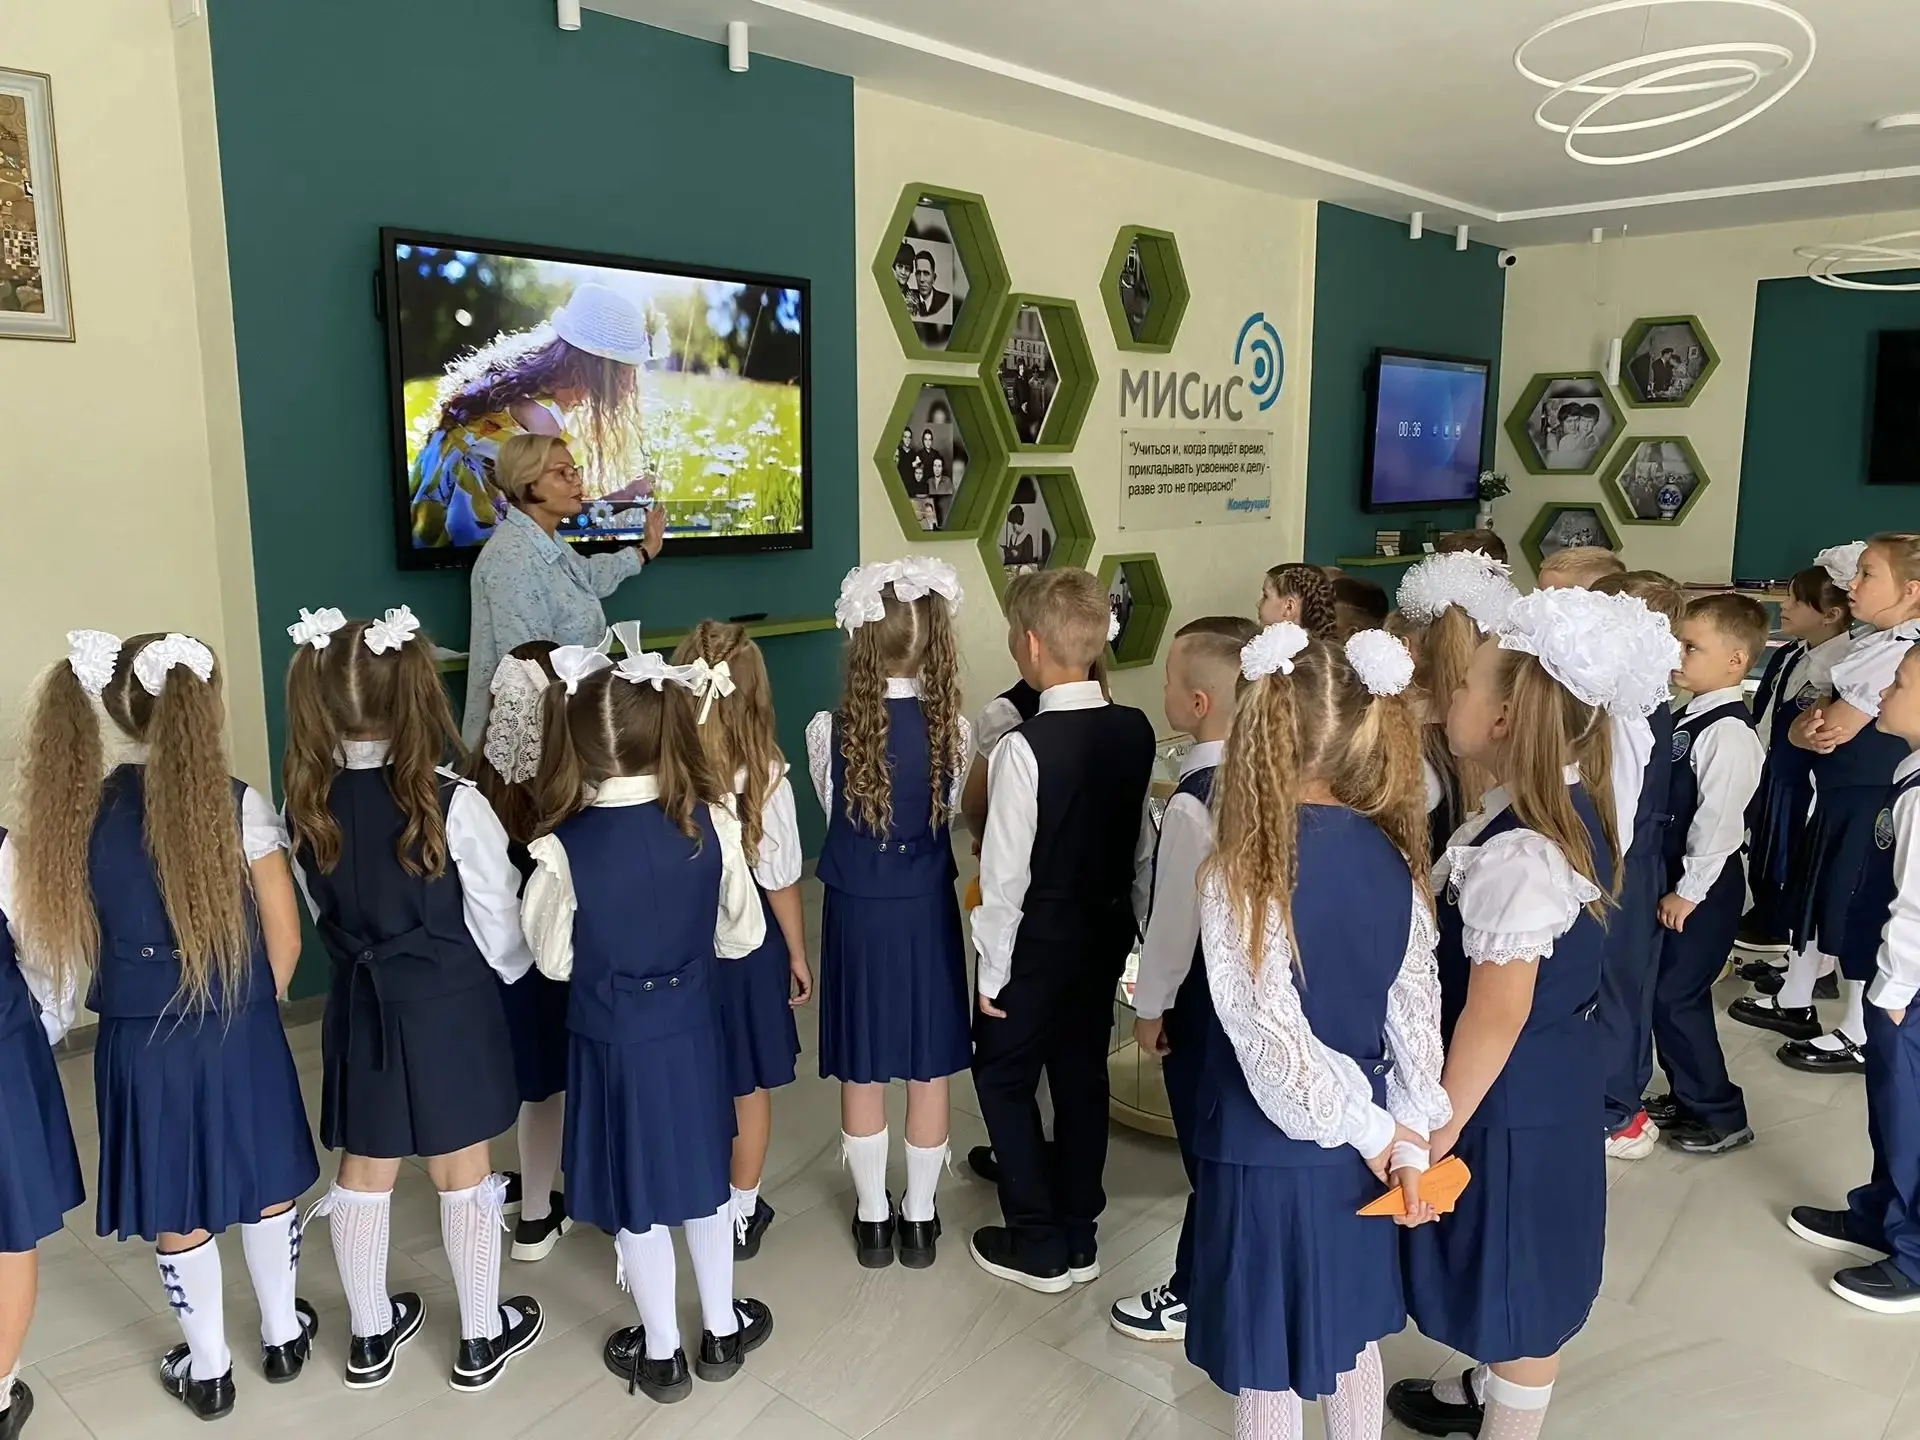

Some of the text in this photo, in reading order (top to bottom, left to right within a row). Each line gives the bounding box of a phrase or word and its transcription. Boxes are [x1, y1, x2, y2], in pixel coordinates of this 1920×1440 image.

[1120, 368, 1244, 422] МИСиС
[1399, 421, 1422, 438] 00:36
[1129, 441, 1266, 457] "Учиться и, когда придёт время,
[1129, 463, 1194, 479] прикладывать
[1196, 462, 1239, 476] усвоенное
[1241, 463, 1246, 473] к
[1247, 462, 1265, 476] делу
[1128, 478, 1237, 500] разве это не прекрасно!"
[1227, 496, 1271, 513] Конфуций
